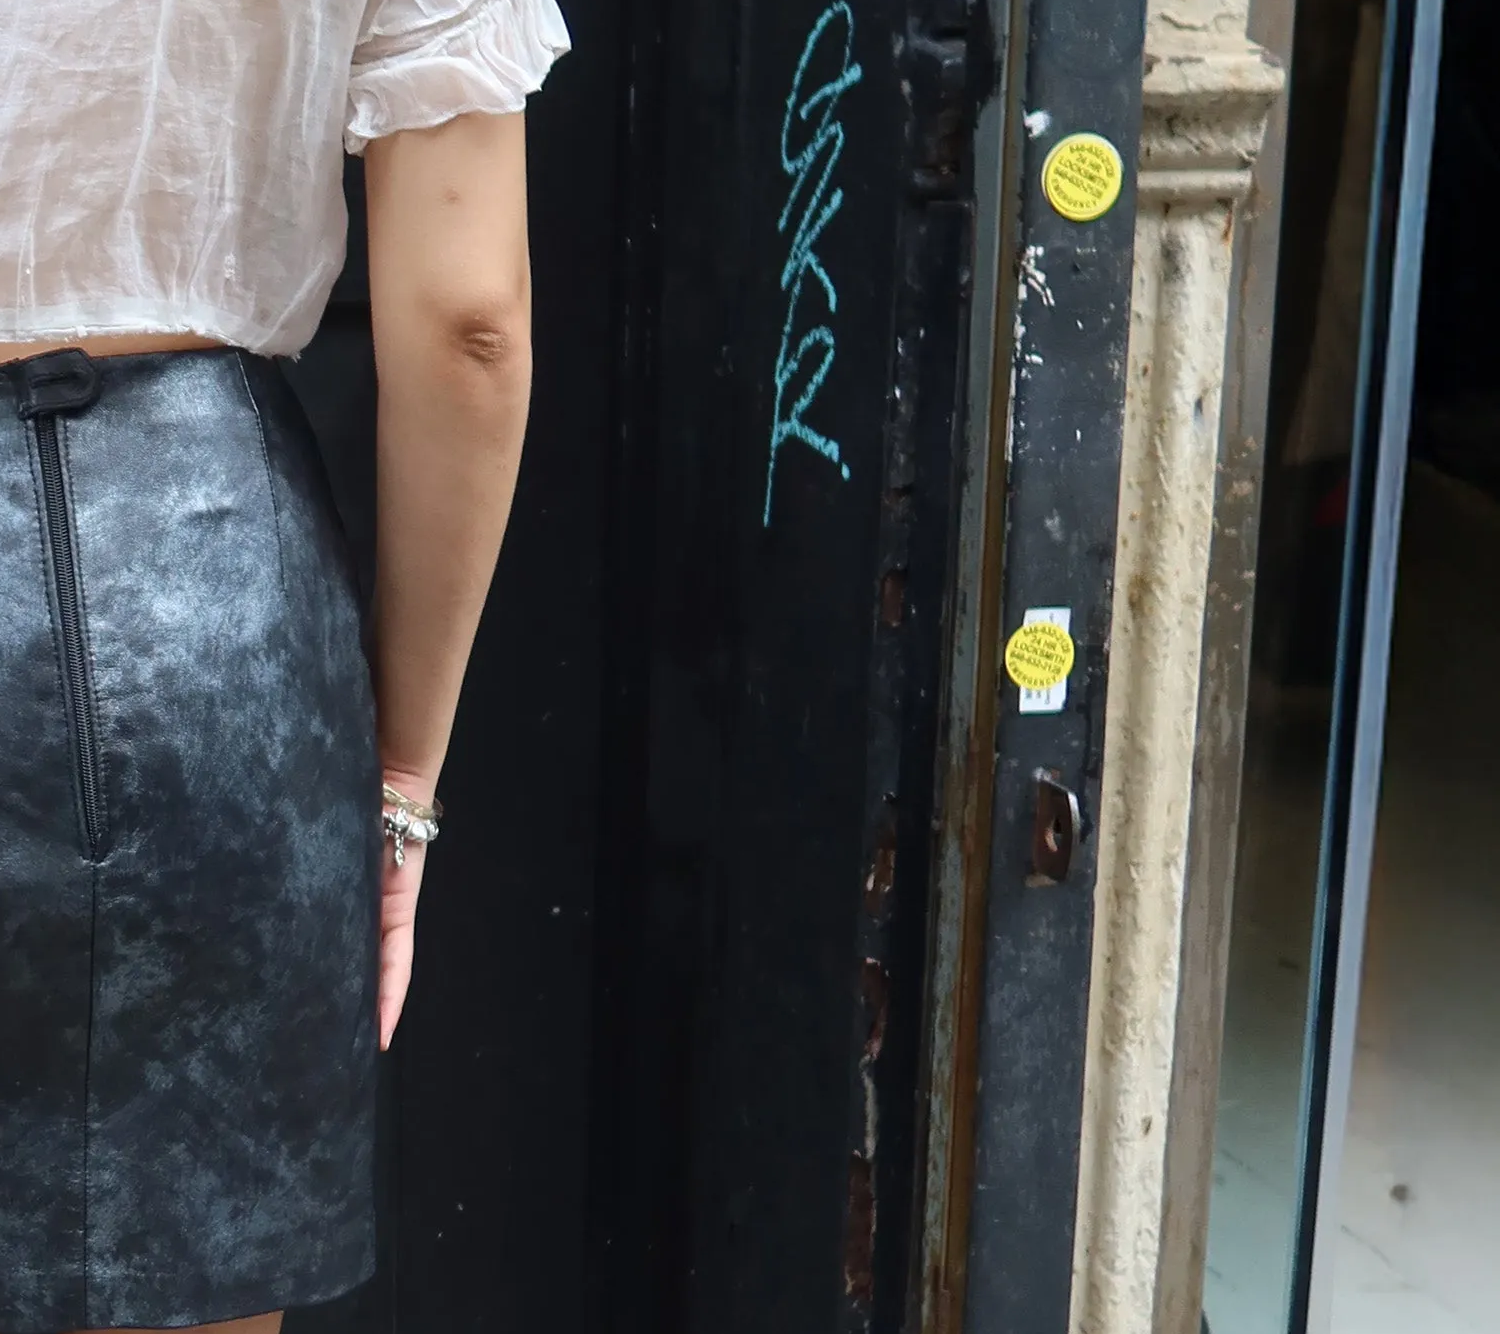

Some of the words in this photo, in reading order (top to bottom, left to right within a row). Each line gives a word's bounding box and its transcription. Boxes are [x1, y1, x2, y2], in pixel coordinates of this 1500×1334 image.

[1057, 154, 1109, 190] LOCKSMITH
[1012, 639, 1067, 666] LOCKSMITH
[1031, 634, 1043, 646] 24
[1043, 640, 1058, 652] HR
[1008, 660, 1058, 686] EMERGENCY
